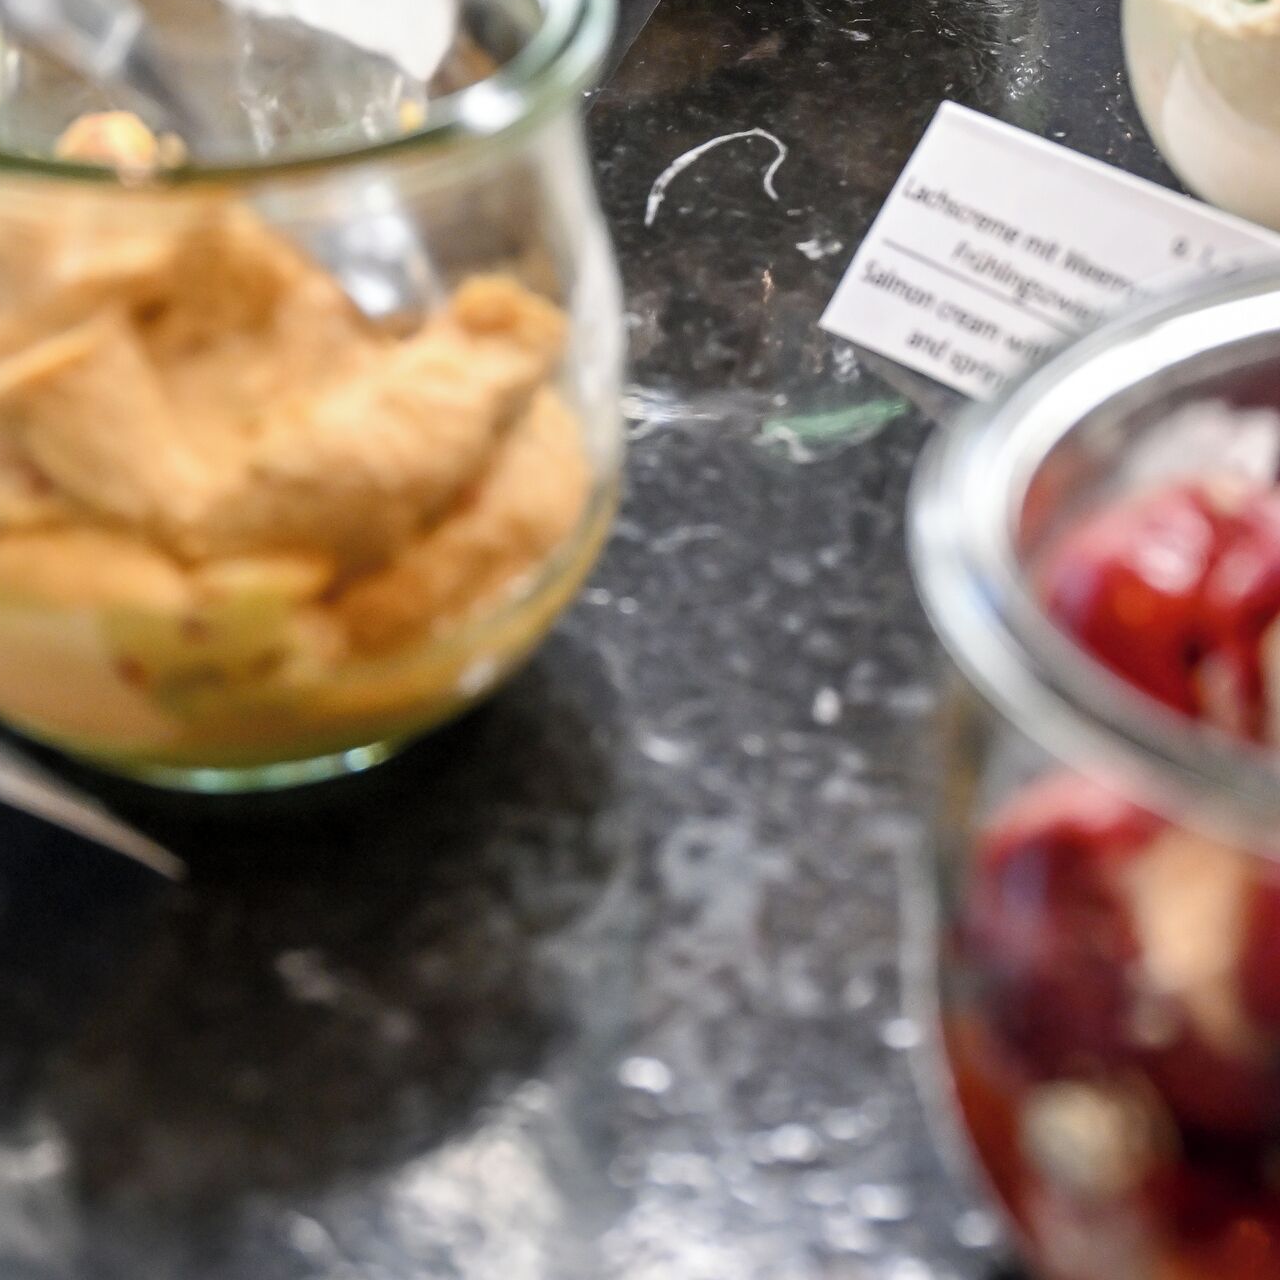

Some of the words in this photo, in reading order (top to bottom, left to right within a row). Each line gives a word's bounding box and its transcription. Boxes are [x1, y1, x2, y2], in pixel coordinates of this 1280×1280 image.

[901, 174, 1021, 246] Lachscreme
[1021, 233, 1062, 262] mit
[859, 258, 936, 312] Salmon
[936, 294, 1000, 344] cream
[905, 326, 946, 360] and
